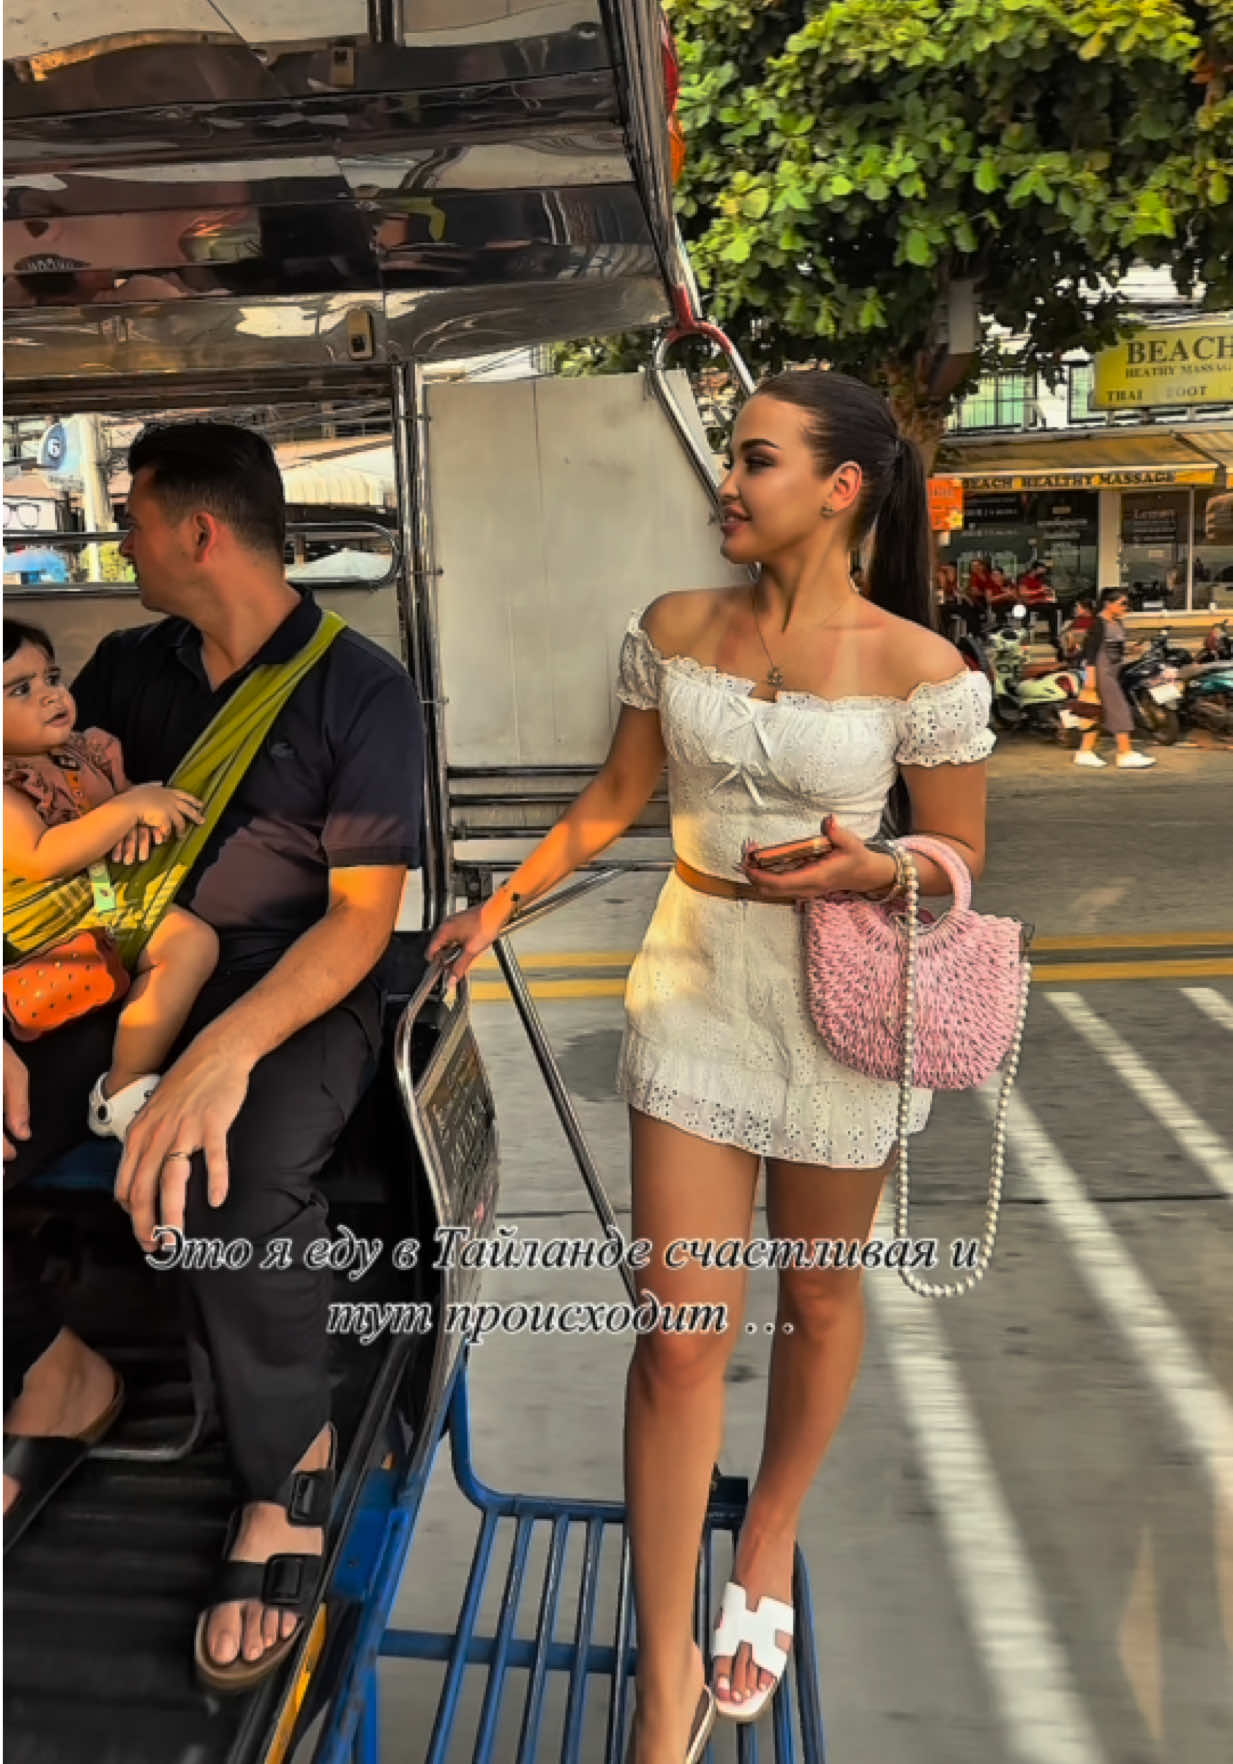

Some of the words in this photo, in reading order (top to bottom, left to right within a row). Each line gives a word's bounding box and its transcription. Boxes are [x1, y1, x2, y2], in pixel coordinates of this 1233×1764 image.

[1127, 335, 1233, 364] BEACH
[1106, 390, 1143, 401] THAI
[1021, 473, 1092, 489] HEALTHY
[1099, 470, 1175, 486] MASSAGE
